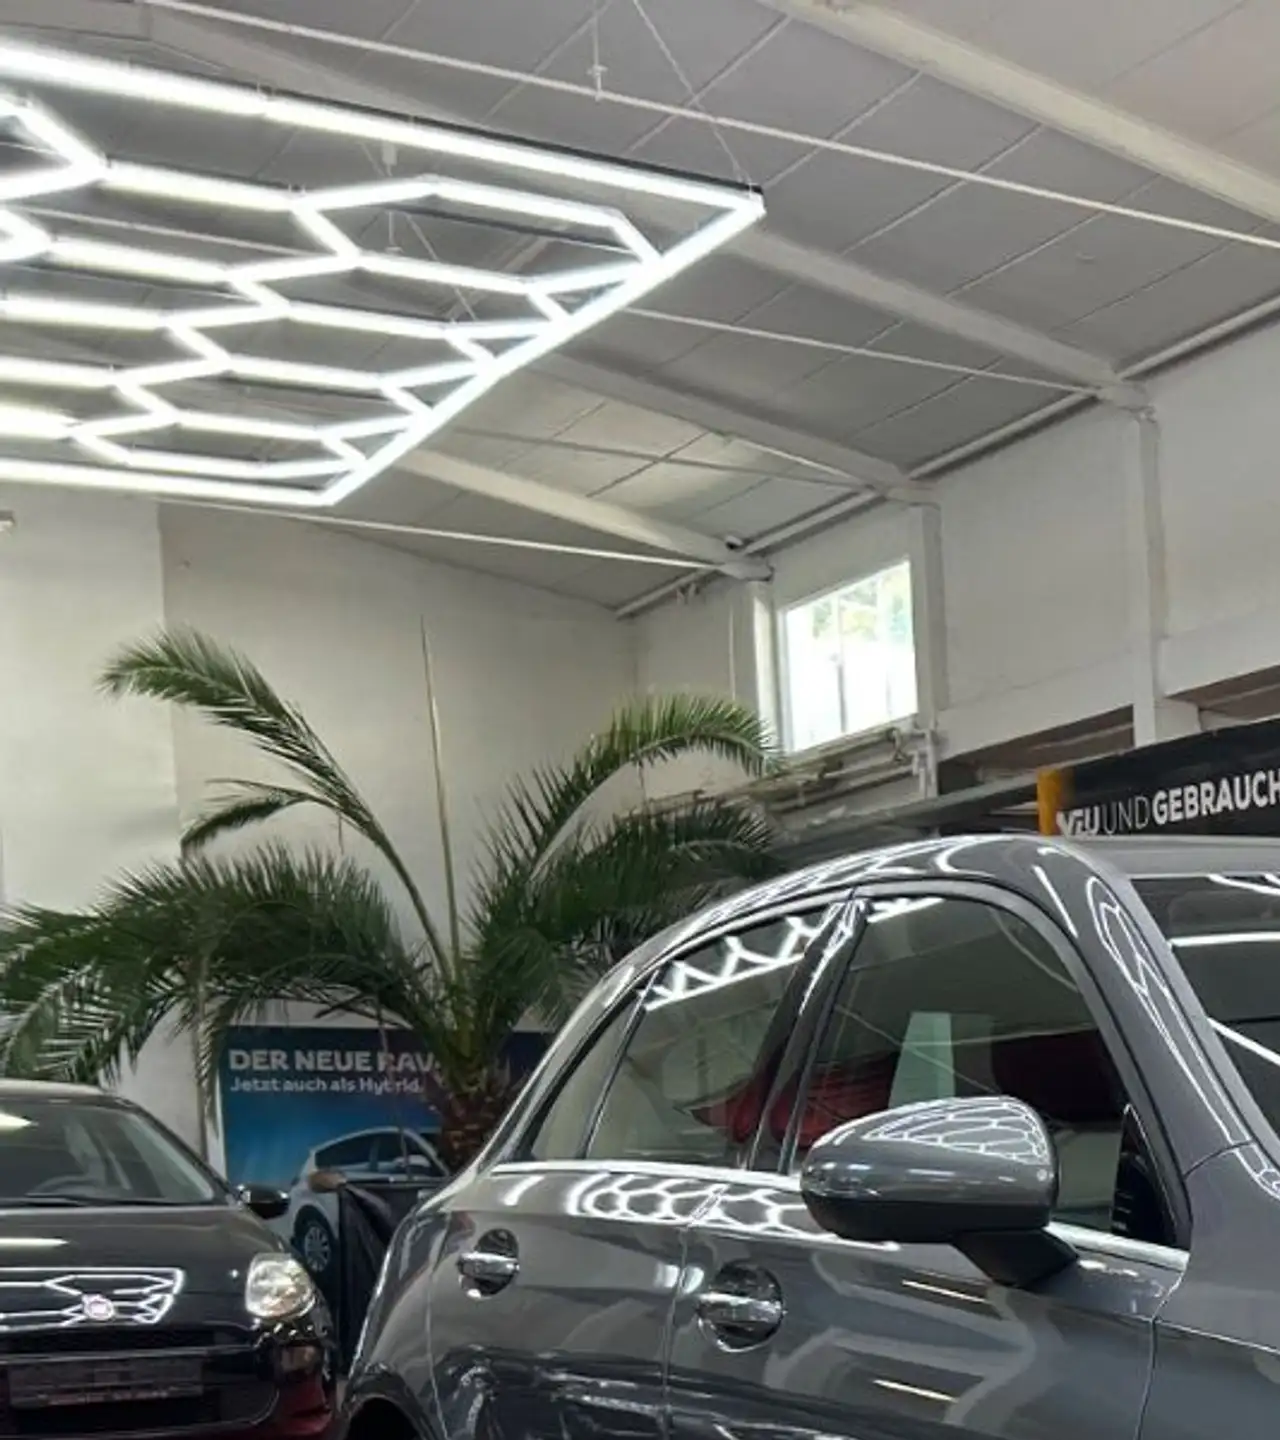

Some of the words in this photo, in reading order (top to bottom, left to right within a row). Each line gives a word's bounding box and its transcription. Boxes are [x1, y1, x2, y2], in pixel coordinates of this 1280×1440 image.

[228, 1049, 288, 1071] DER
[294, 1049, 373, 1072] NEUE
[377, 1051, 440, 1072] RAV
[230, 1077, 280, 1093] Jetzt
[283, 1078, 328, 1093] auch
[331, 1078, 357, 1093] als
